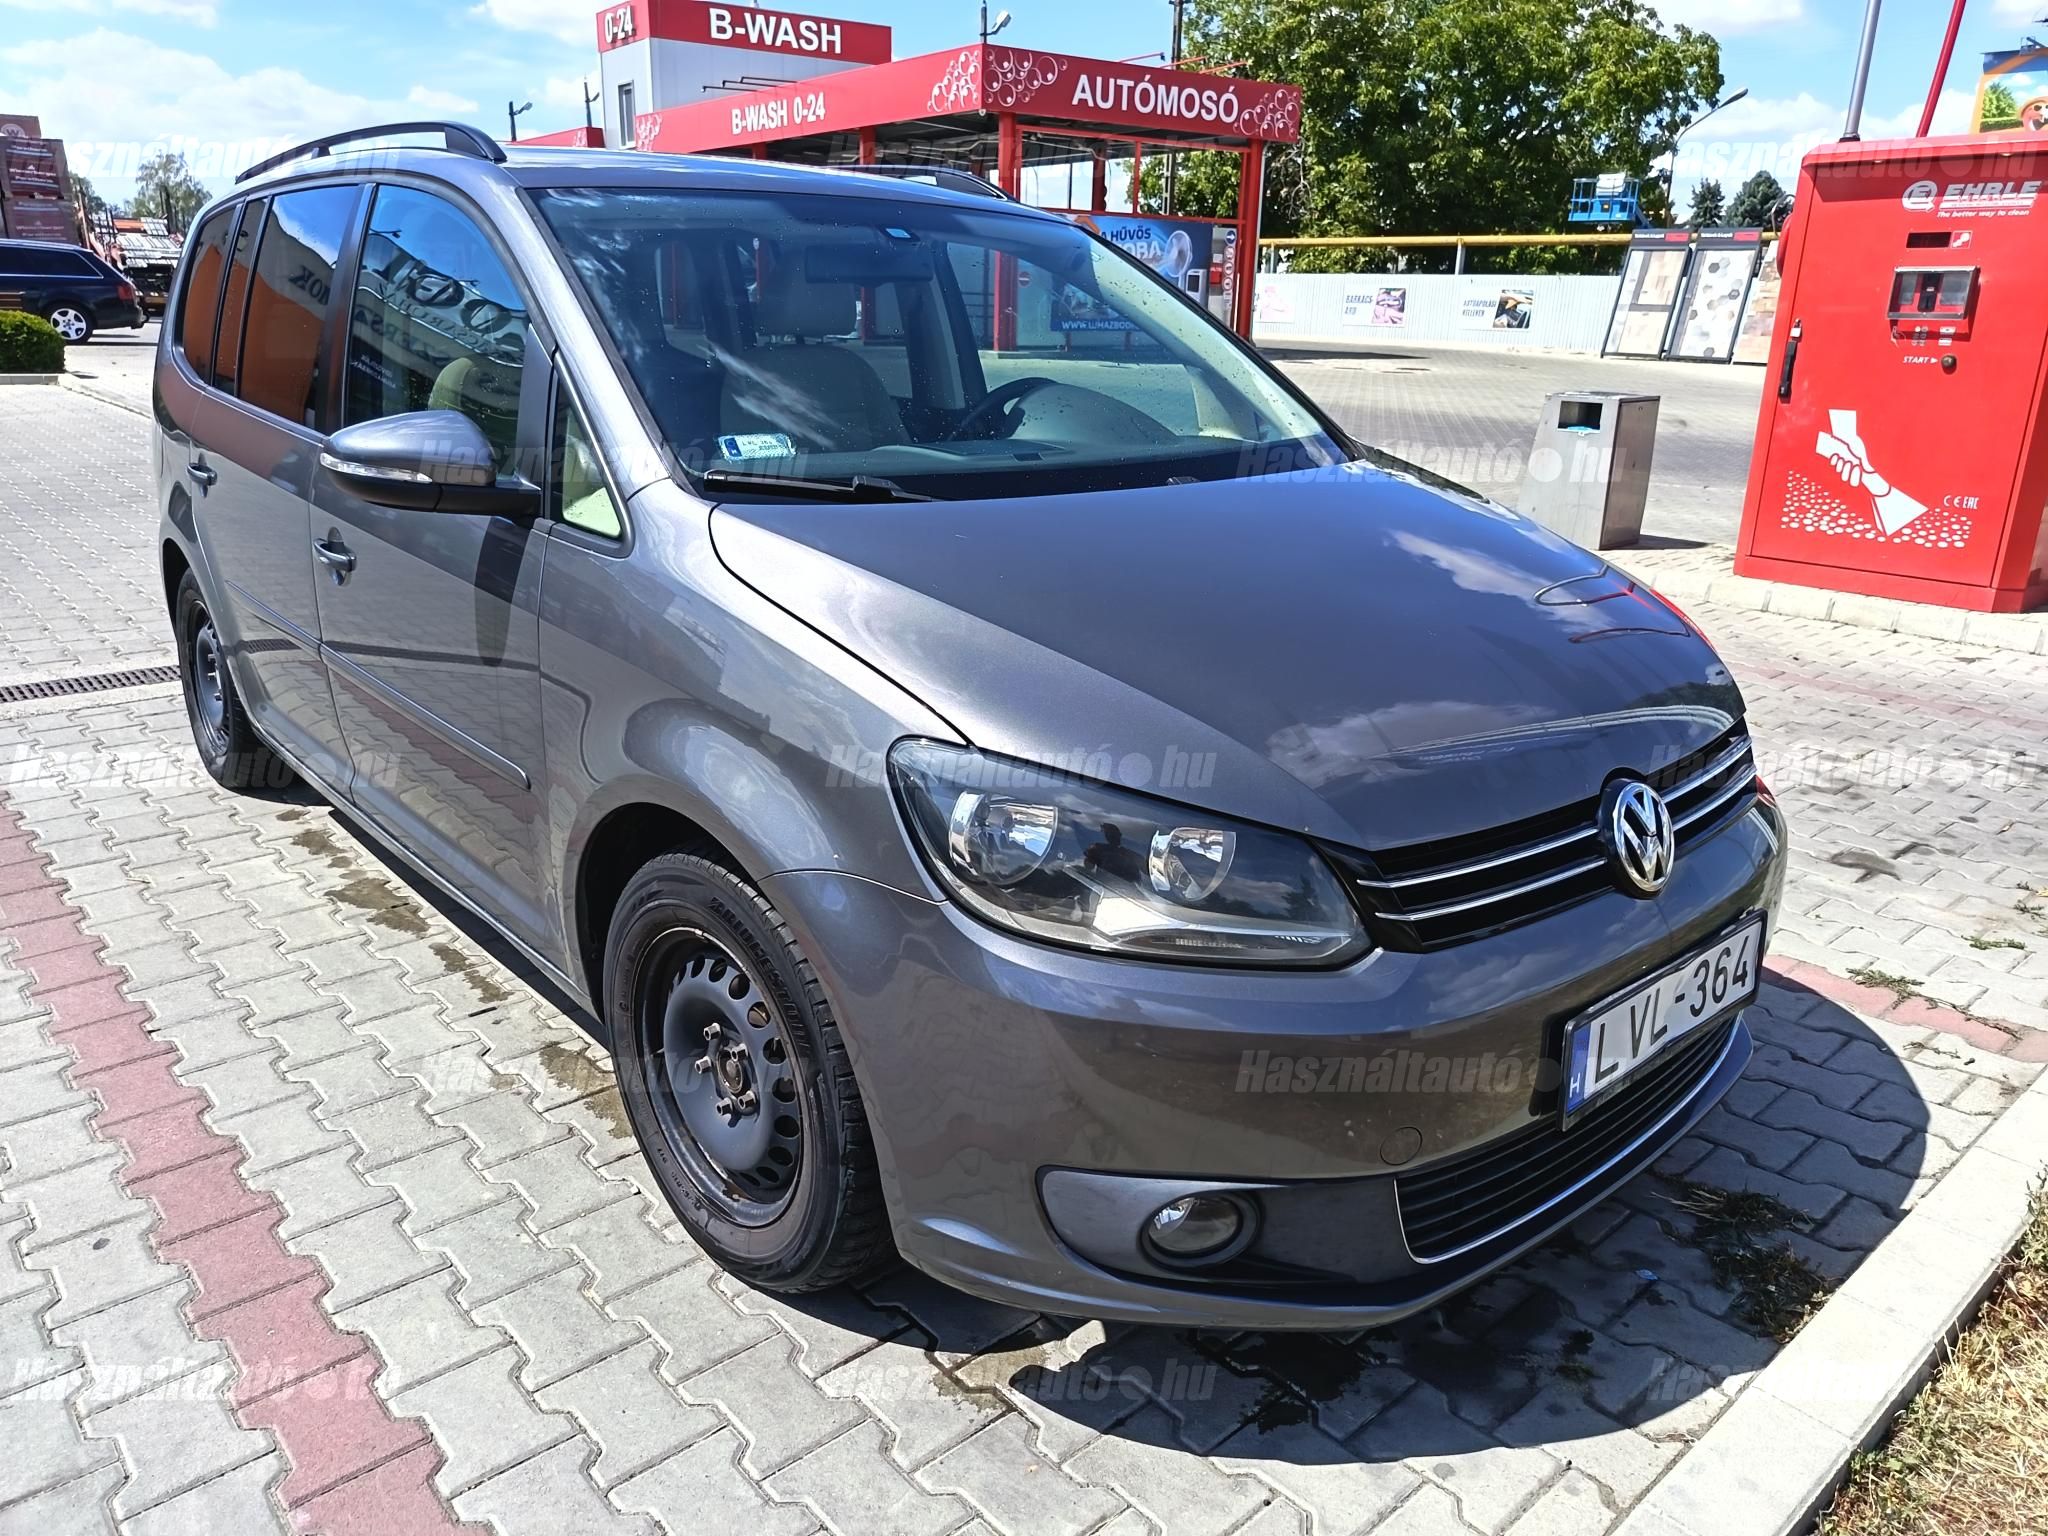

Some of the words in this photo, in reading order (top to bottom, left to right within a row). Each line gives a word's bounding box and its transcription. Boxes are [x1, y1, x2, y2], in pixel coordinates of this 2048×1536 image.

[604, 5, 634, 43] 0-24
[709, 7, 842, 54] B-WASH
[731, 99, 788, 135] B-WASH
[793, 92, 827, 123] 0-24
[1071, 74, 1240, 124] AUTÓMOSÓ
[1942, 180, 2042, 203] EHRLE
[1951, 210, 1977, 218] better
[1978, 210, 1997, 219] way
[1997, 208, 2006, 217] to
[2007, 208, 2030, 217] clean
[1110, 224, 1152, 243] HŰVÖS
[1902, 356, 1930, 365] START
[1594, 934, 1750, 1085] LVL-364
[1568, 1072, 1582, 1099] H
